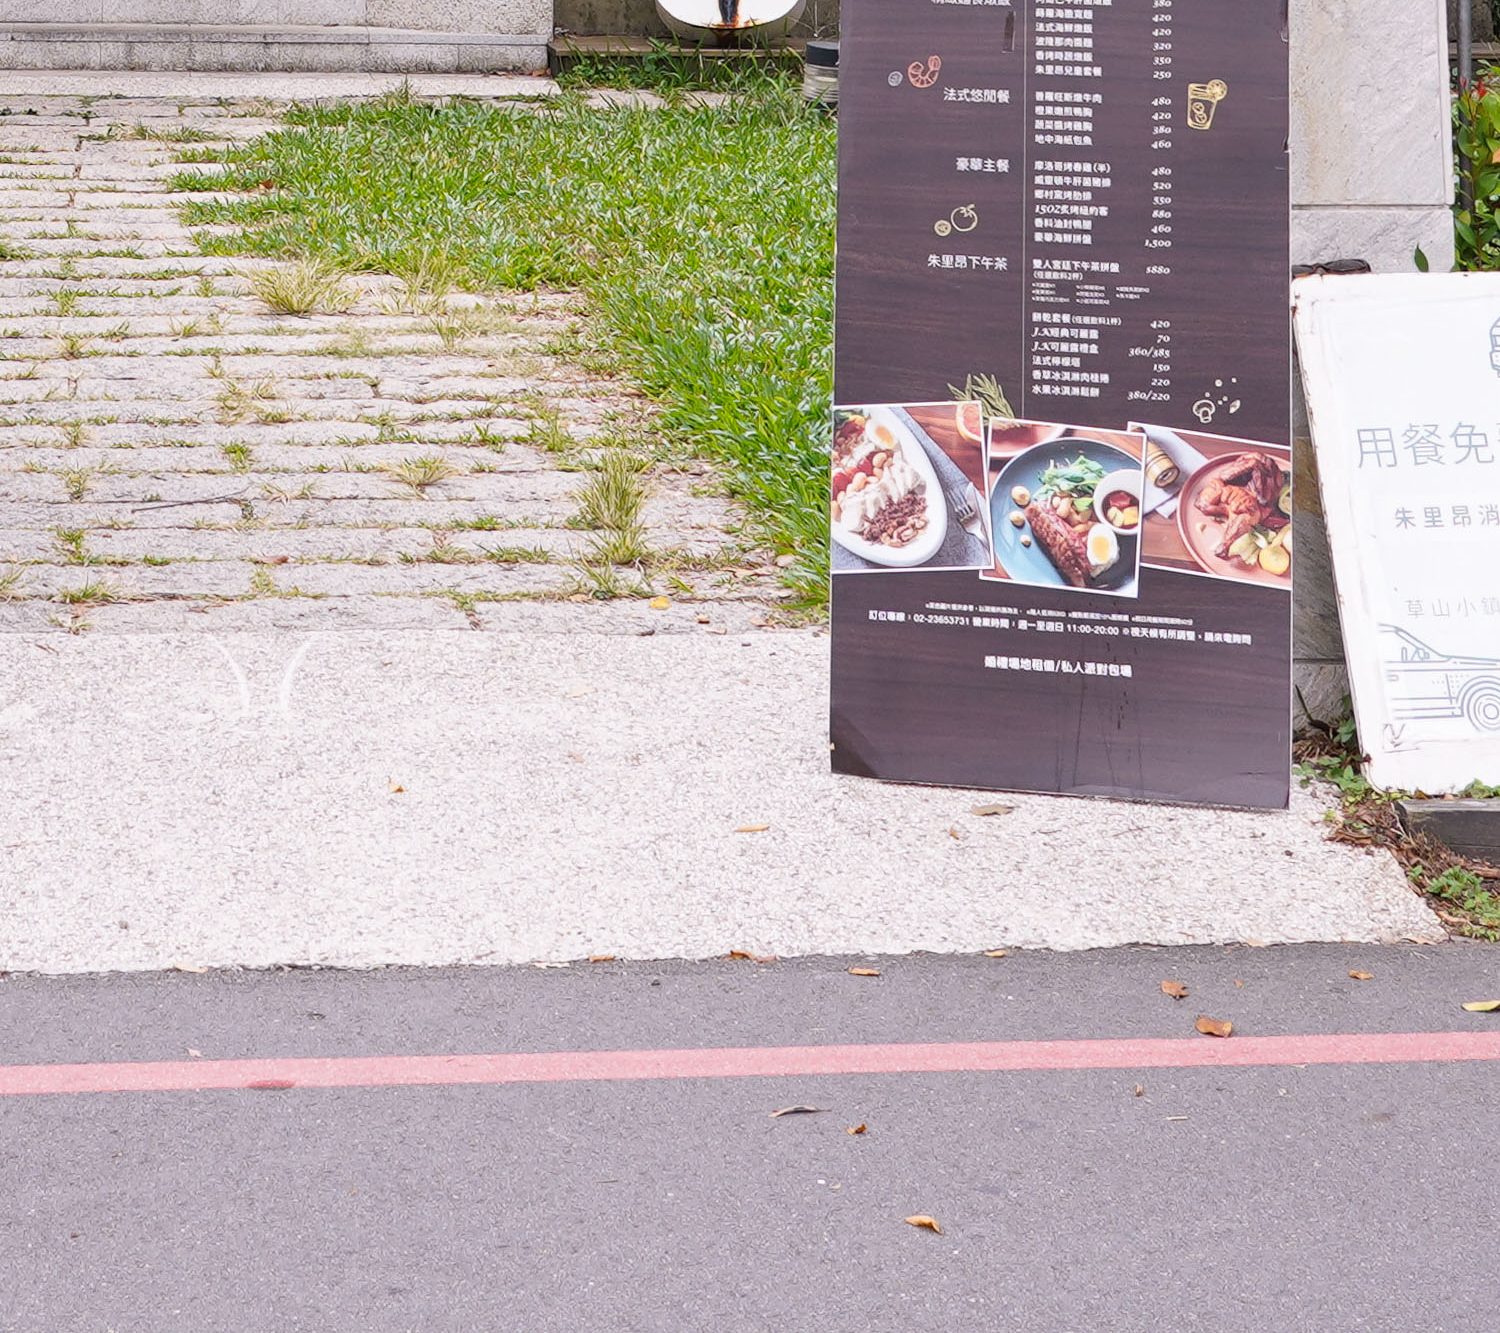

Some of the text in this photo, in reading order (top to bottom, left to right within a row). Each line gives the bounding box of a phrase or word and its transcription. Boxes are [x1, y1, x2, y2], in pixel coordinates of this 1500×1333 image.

[944, 87, 1010, 103] 法式悠閒餐
[956, 158, 1009, 172] 豪華主餐
[928, 254, 1007, 270] 朱里昂下午茶
[1067, 624, 1119, 636] 11:00-20:00
